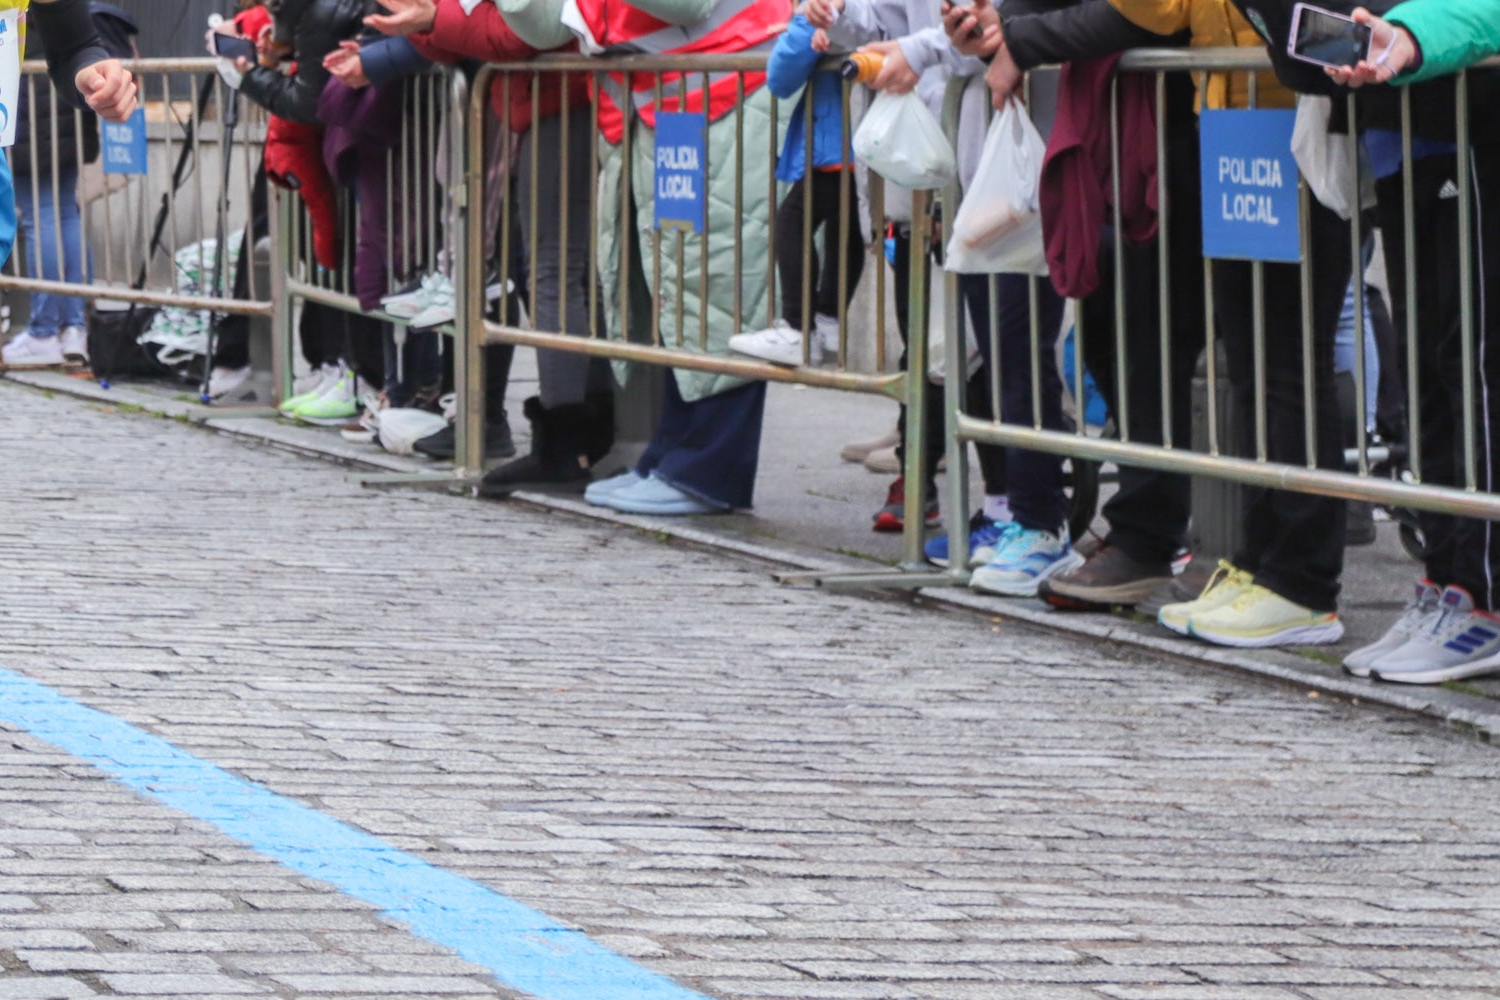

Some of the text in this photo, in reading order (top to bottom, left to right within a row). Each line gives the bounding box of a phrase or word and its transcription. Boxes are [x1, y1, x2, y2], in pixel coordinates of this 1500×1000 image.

[656, 145, 699, 170] POLICIA
[658, 174, 697, 199] LOCAL
[1219, 157, 1283, 188] POLICIA
[1222, 193, 1279, 226] LOCAL
